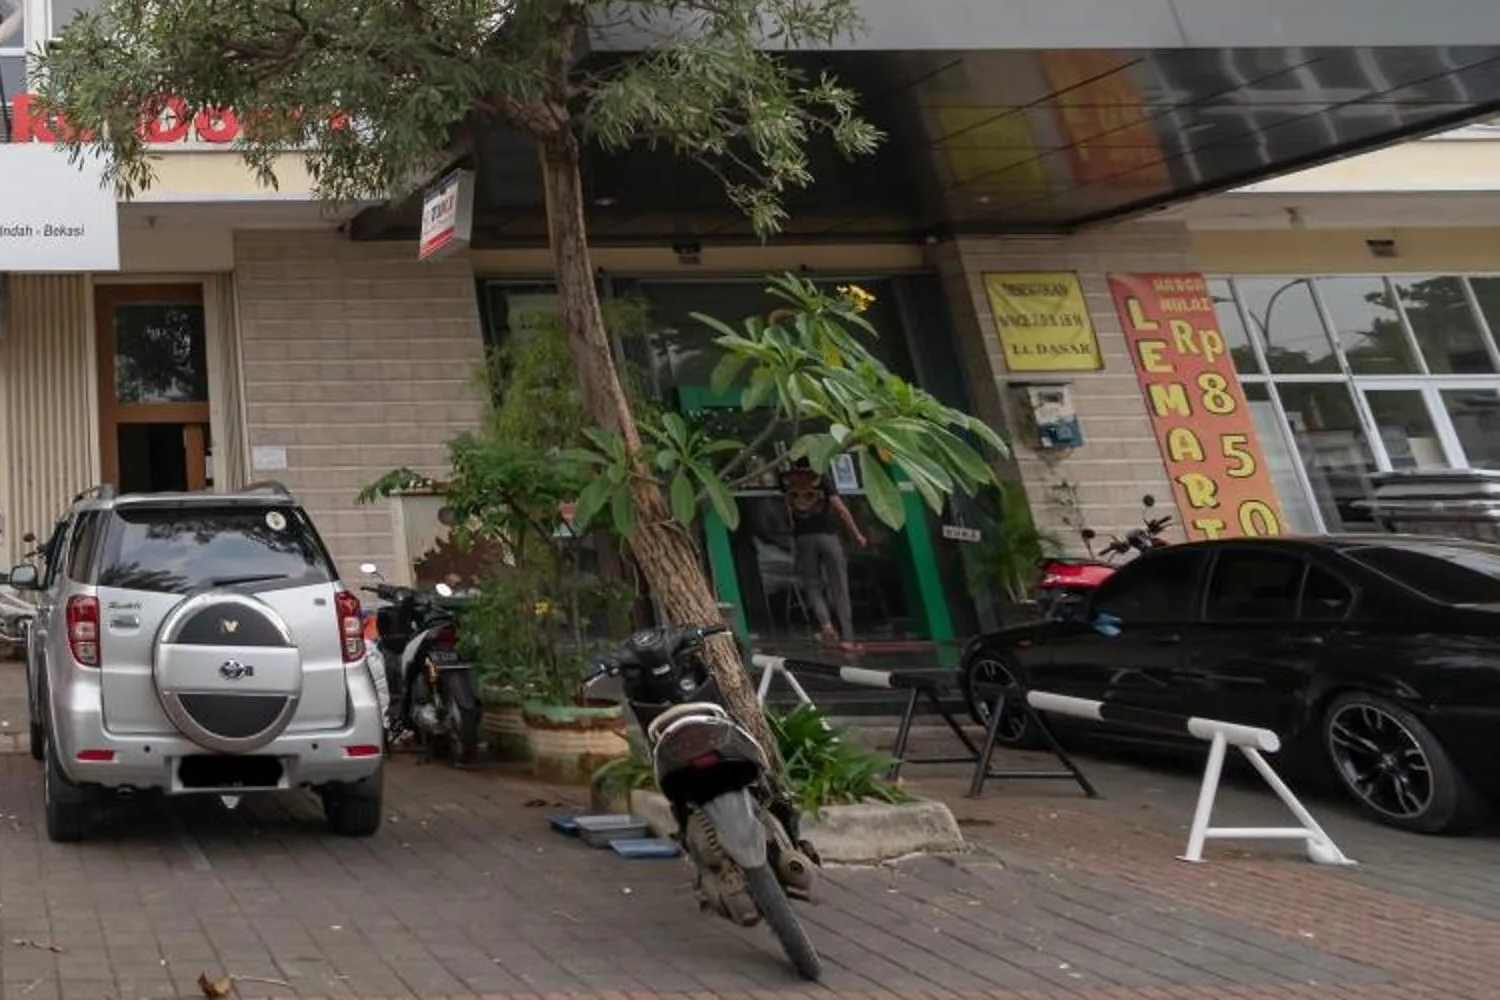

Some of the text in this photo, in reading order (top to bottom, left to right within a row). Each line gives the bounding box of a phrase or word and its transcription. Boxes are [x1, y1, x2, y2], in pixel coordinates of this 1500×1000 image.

[0, 224, 33, 237] Indah
[43, 224, 85, 237] Bekasi
[1160, 297, 1213, 313] MULAI
[1169, 319, 1225, 364] Rp
